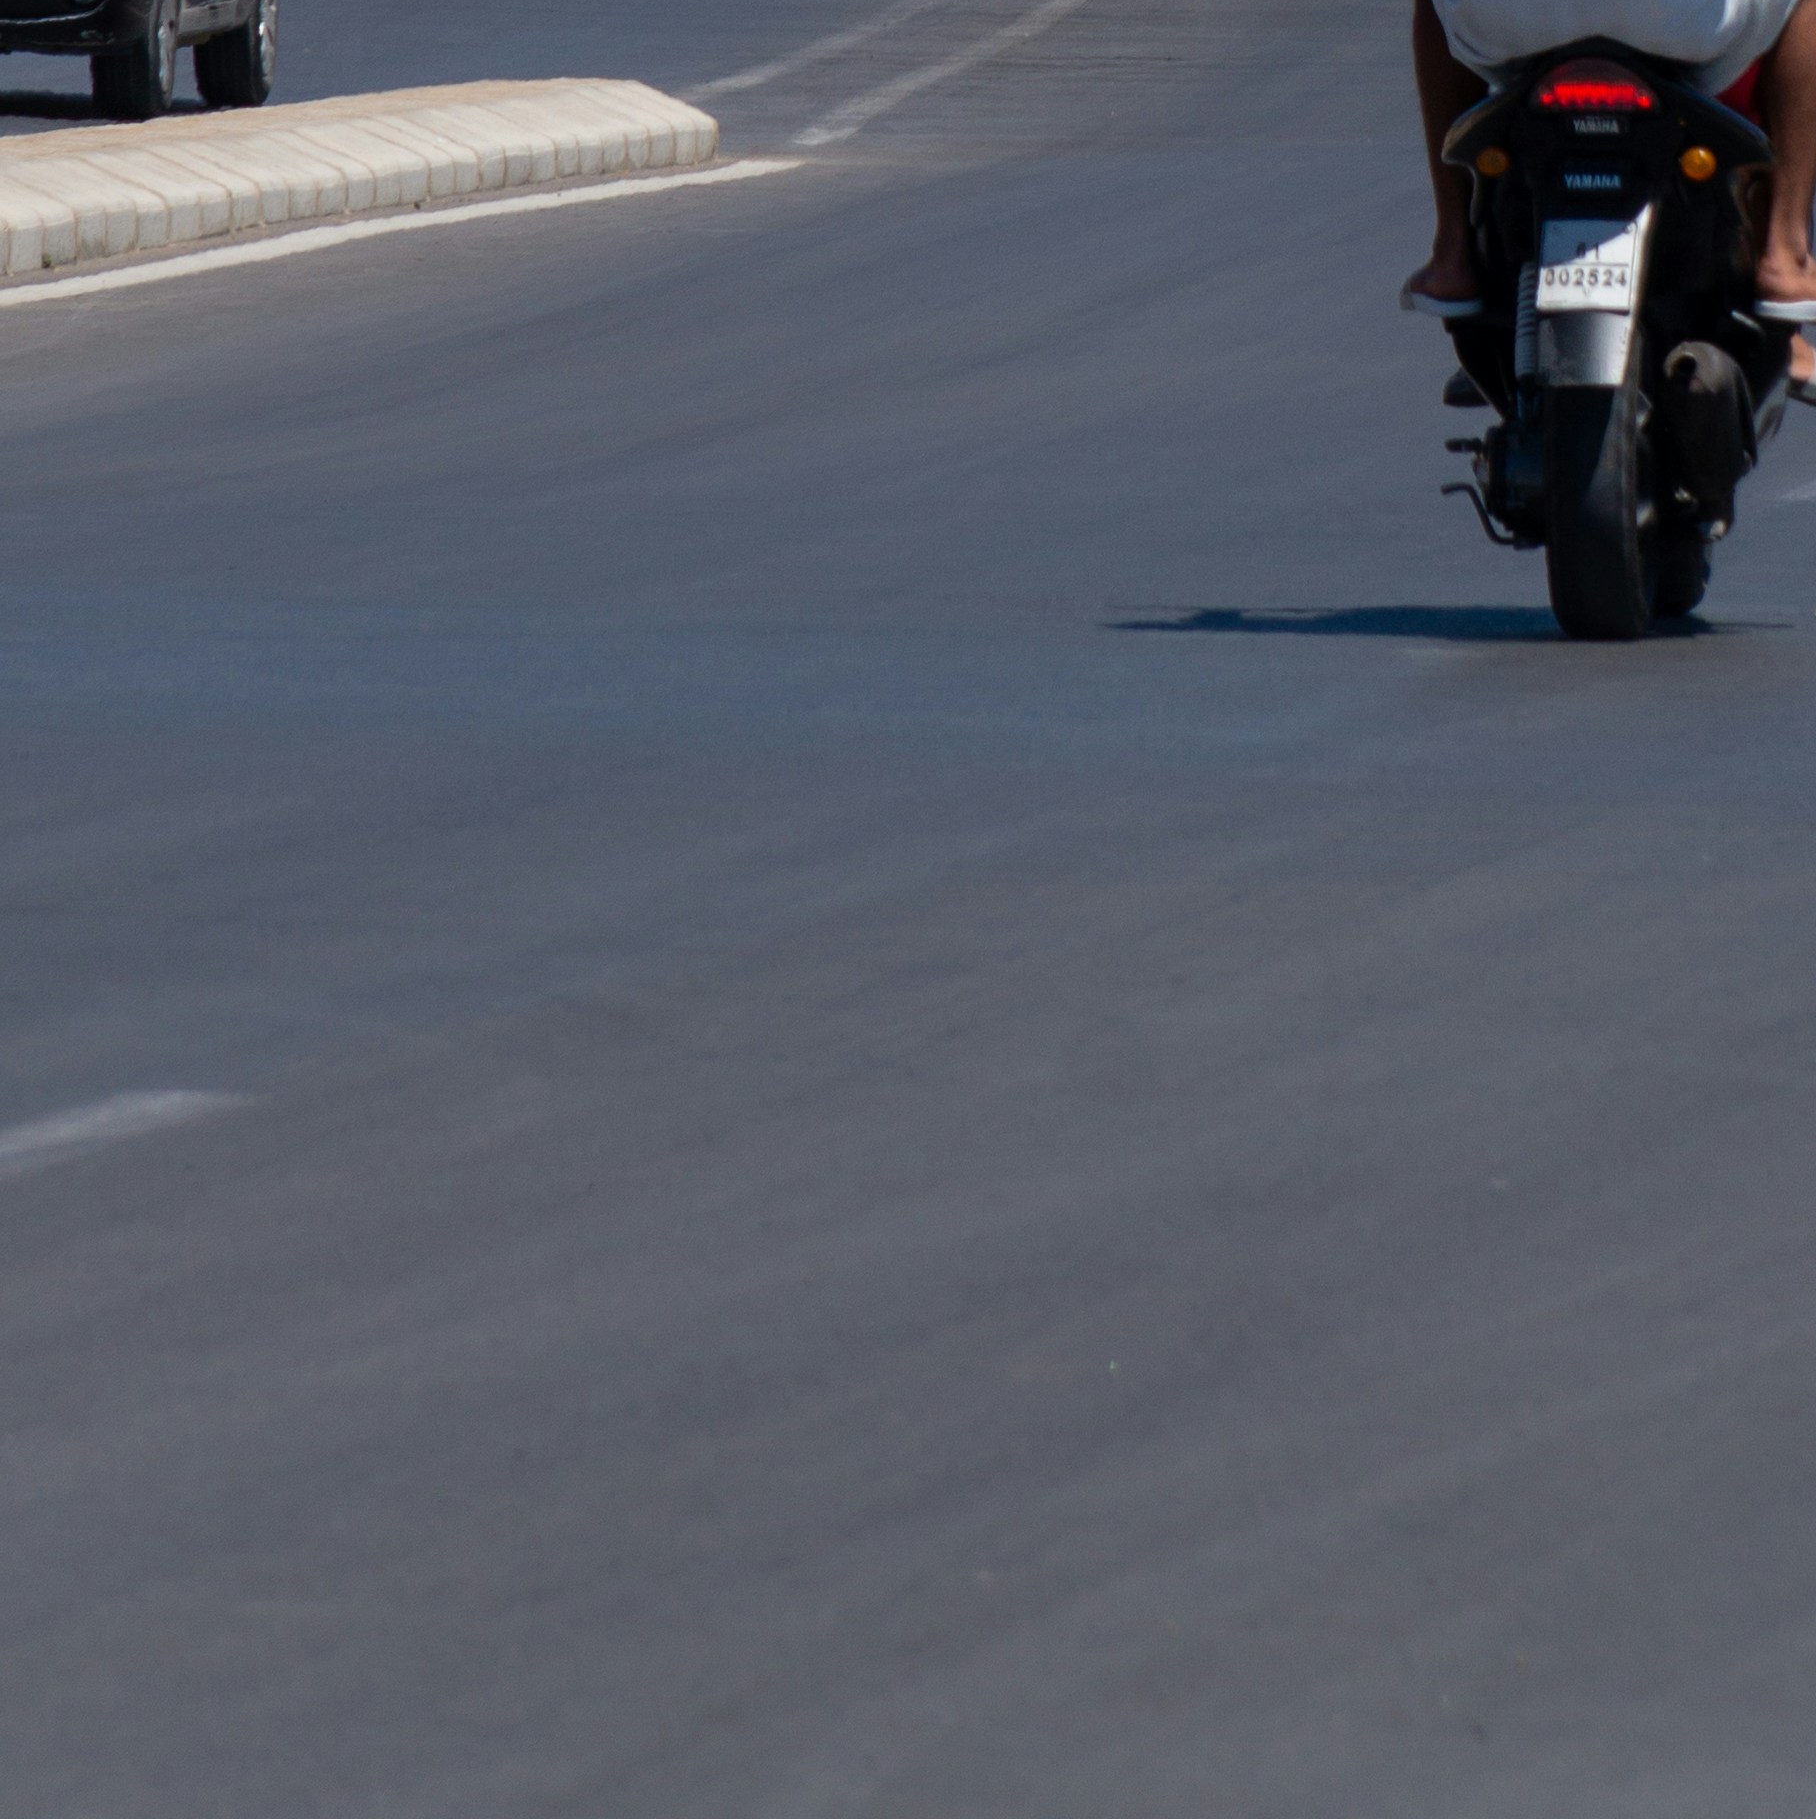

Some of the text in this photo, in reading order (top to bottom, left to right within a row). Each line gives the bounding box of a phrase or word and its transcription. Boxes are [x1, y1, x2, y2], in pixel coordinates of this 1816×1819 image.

[1573, 118, 1620, 134] YAMAHA
[1564, 173, 1622, 189] YAMAHA
[1544, 267, 1627, 286] 002524
